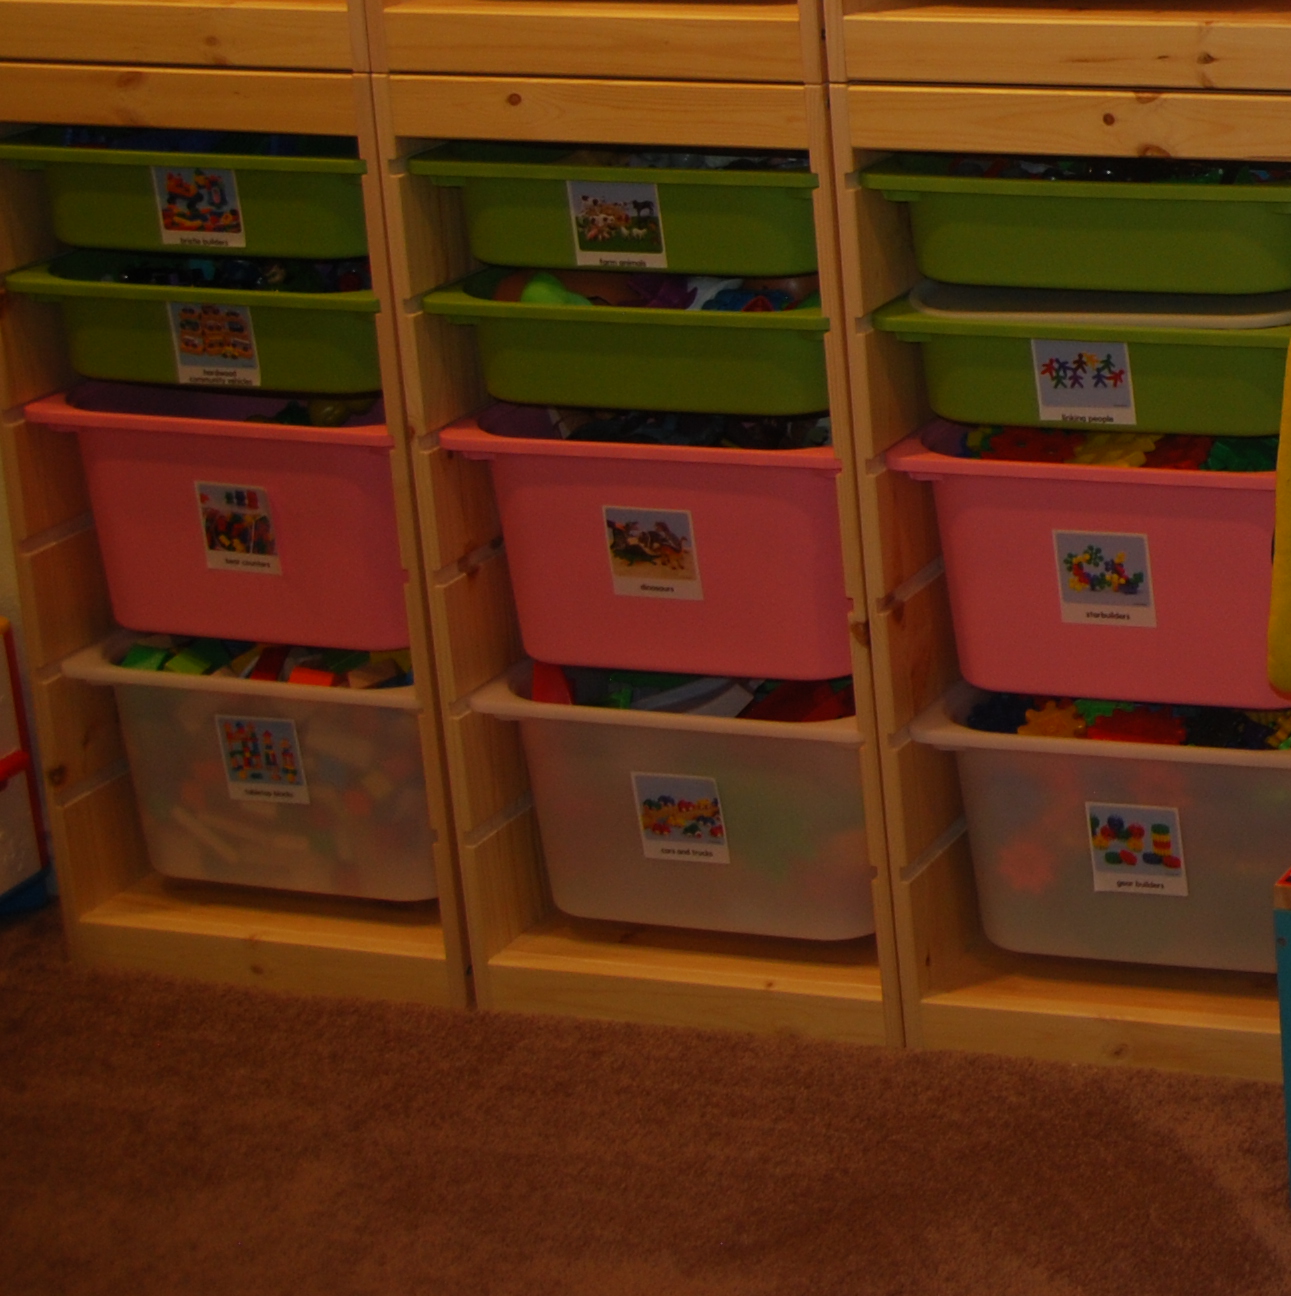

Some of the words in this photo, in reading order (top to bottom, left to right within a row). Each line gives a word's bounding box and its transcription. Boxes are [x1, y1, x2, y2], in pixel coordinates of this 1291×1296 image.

[1062, 414, 1086, 422] linking
[1089, 415, 1114, 423] people
[641, 584, 674, 592] dinosaurs
[1136, 881, 1164, 889] builders
